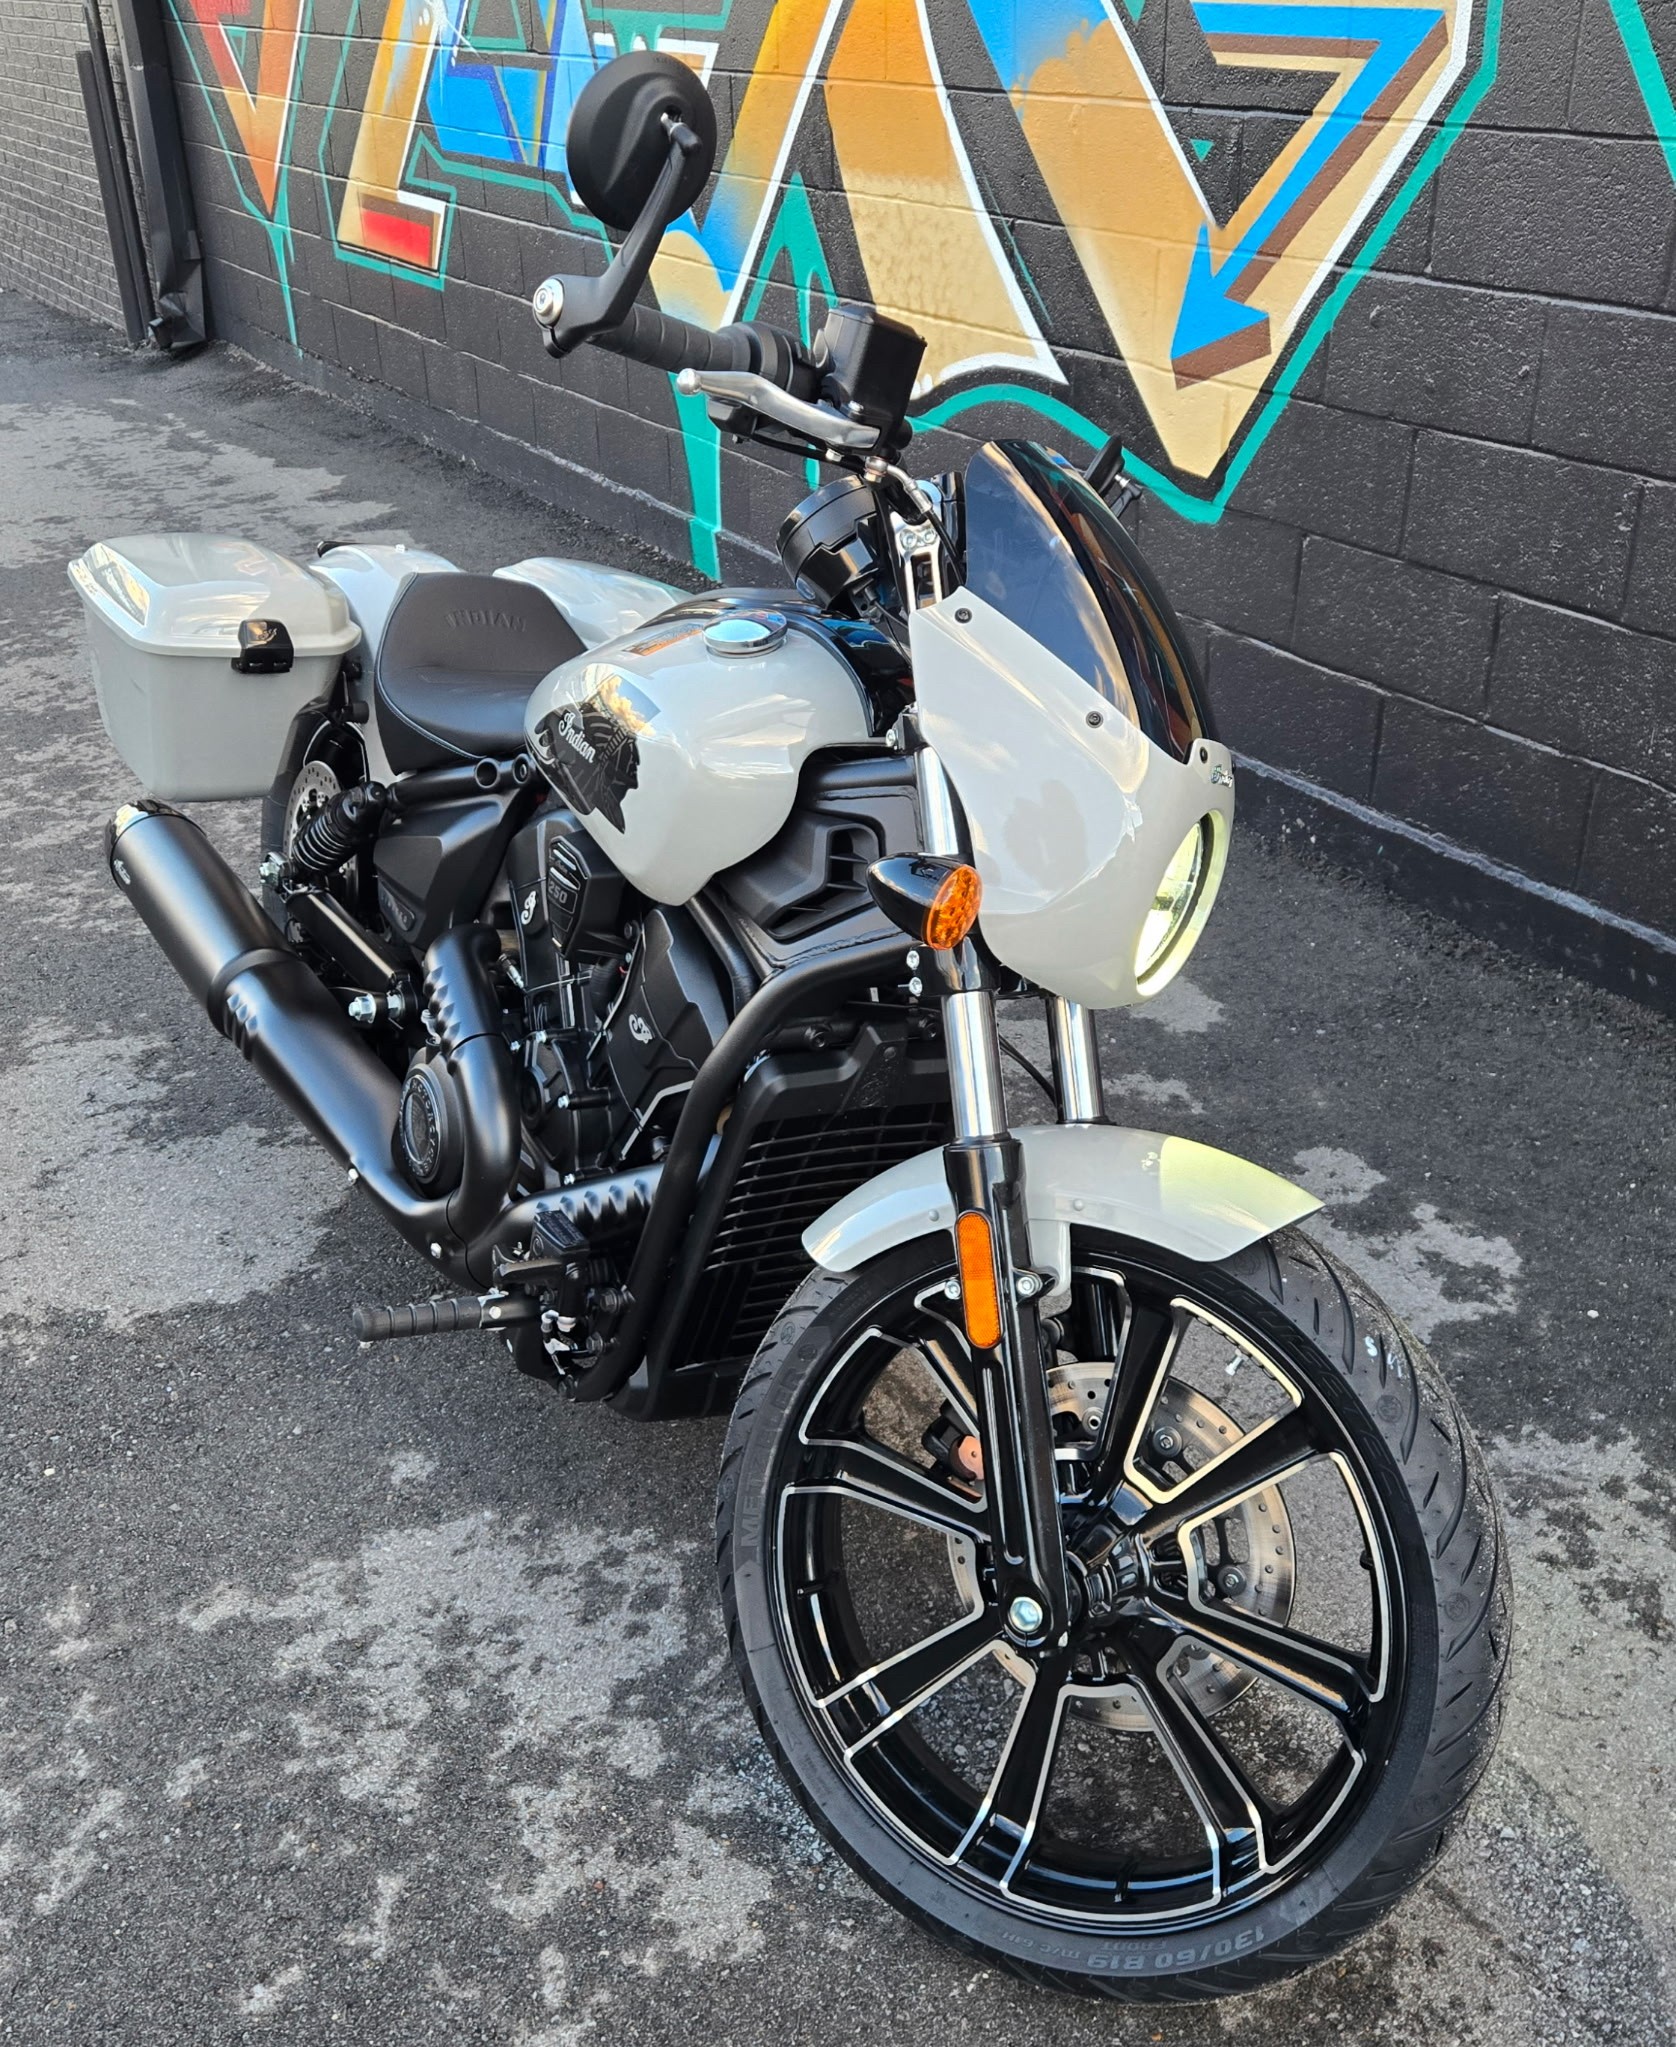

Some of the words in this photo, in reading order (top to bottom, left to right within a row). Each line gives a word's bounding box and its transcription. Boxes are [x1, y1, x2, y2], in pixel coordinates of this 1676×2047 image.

[445, 609, 527, 632] INDIAN
[559, 711, 596, 764] Indian
[1087, 1953, 1144, 1970] B19
[1154, 1926, 1265, 1969] 130/60
